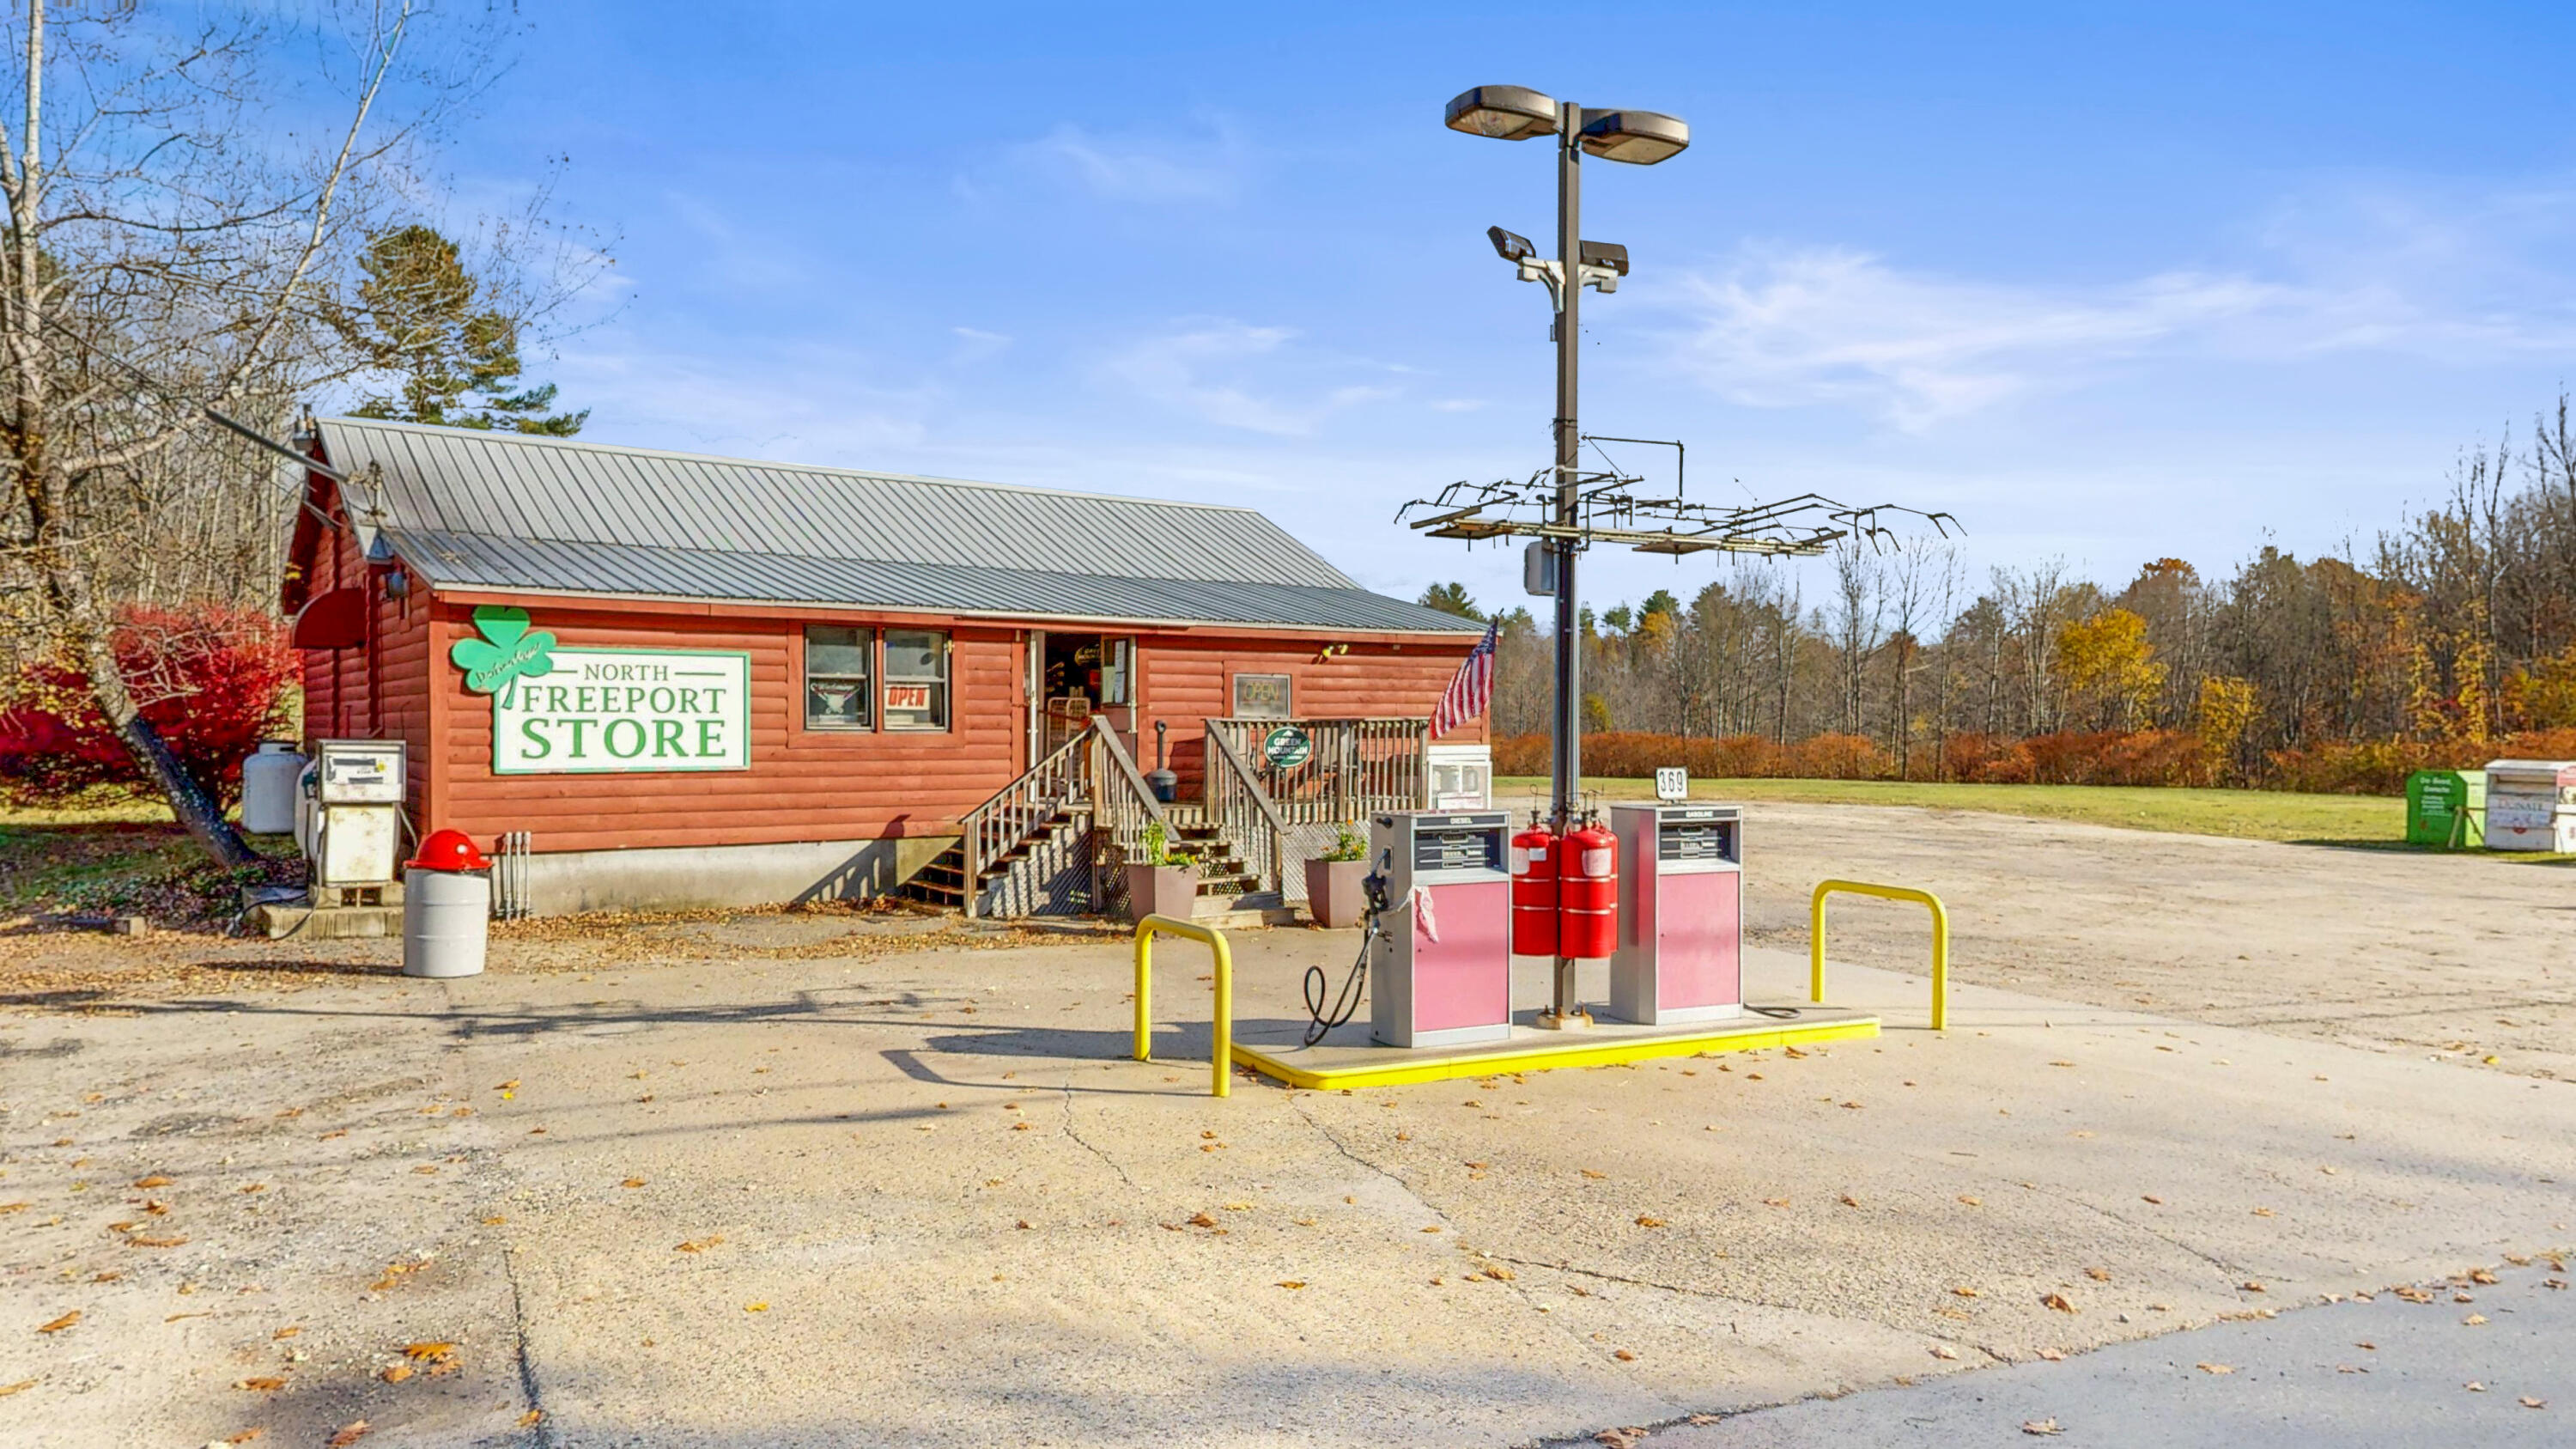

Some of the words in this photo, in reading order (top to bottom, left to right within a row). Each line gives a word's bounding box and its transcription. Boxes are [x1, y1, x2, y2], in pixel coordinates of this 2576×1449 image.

[584, 663, 669, 681] NORTH
[521, 685, 727, 714] FREEPORT
[888, 686, 926, 707] OPEN
[1243, 682, 1279, 701] OPEN
[521, 718, 726, 759] STORE
[1273, 737, 1301, 746] GREEN
[1267, 746, 1308, 755] MOUNTAIN
[1659, 771, 1683, 792] 369
